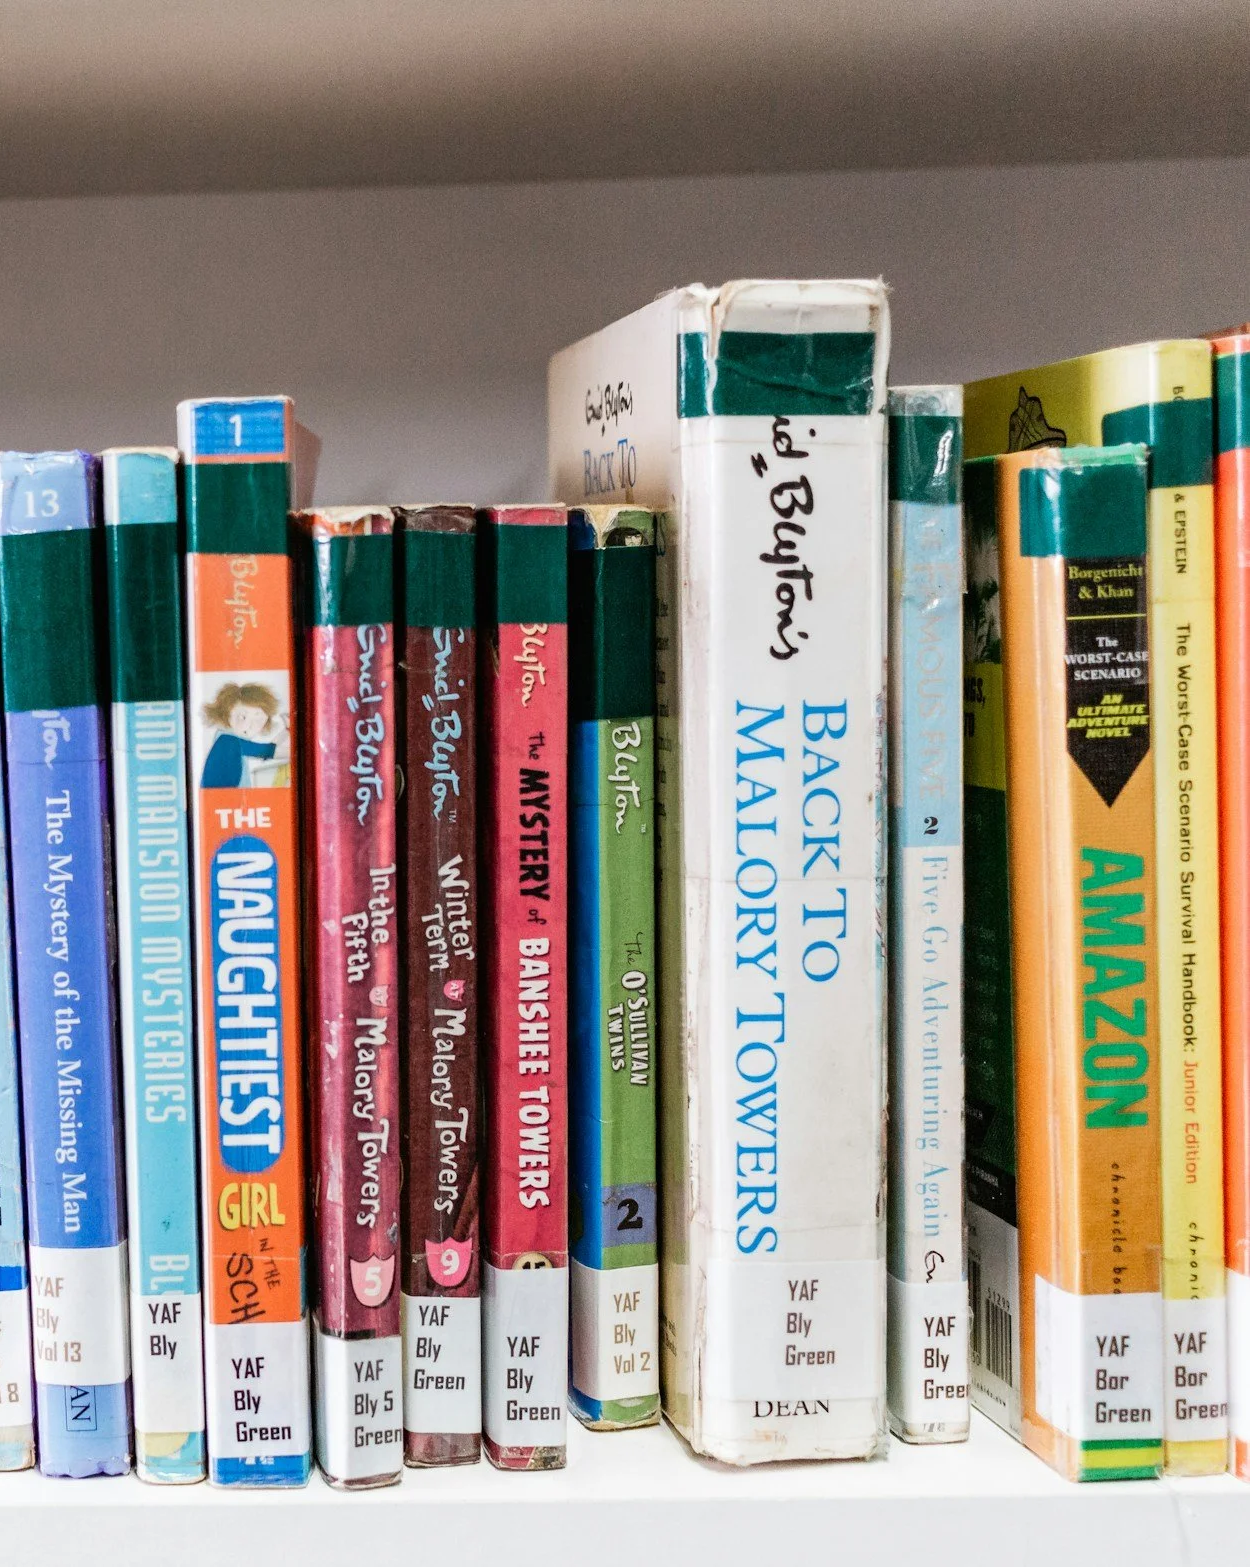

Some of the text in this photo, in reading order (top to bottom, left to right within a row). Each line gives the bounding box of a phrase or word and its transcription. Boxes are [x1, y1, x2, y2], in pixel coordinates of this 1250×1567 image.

[24, 490, 60, 518] 13
[1174, 511, 1190, 574] EPSTEIN
[759, 475, 815, 661] Blyton's
[1068, 564, 1144, 583] Borgenicht
[1097, 585, 1135, 599] Khan
[1064, 650, 1149, 665] WORST-CASE
[1074, 667, 1142, 681] SCENARIO
[1066, 715, 1150, 729] ADVENTURE
[1077, 704, 1146, 718] ULTIMATE
[350, 711, 384, 827] Blyton
[424, 710, 461, 820] Blyton
[608, 721, 641, 834] Blyton
[214, 806, 272, 831] THE
[922, 816, 939, 836] 2
[801, 699, 848, 985] BACK TO
[437, 854, 474, 961] Winter
[1177, 622, 1201, 1185] The Worst-Case Scenario Survival Junior Edition
[342, 911, 371, 983] Fifth
[422, 903, 449, 972] Term
[518, 731, 550, 1209] The MYSTERY BANSHEE TOWERS
[736, 700, 786, 1255] MALORY TOWERS
[1080, 846, 1150, 1129] AMAZON
[43, 790, 87, 1234] The Mystery of the Missing Man
[216, 850, 282, 1156] NAUGHTIEST
[607, 1002, 625, 1072] TWINS
[914, 856, 949, 1237] Five Go Adventuring Again
[352, 1017, 387, 1122] Malory
[430, 1008, 466, 1110] Malory
[434, 1106, 469, 1214] Towers
[356, 1118, 389, 1229] Towers
[217, 1182, 286, 1232] GIRL
[616, 1198, 644, 1231] 2
[440, 1248, 459, 1276] 9
[363, 1266, 381, 1296] 5
[787, 1279, 819, 1301] YAF
[148, 1302, 181, 1324] YAF
[418, 1305, 450, 1327] YAF
[786, 1313, 812, 1337] Bly
[924, 1316, 955, 1338] YAF
[150, 1335, 177, 1360] Bly
[416, 1338, 441, 1362] Bly
[507, 1337, 540, 1358] YAF
[1096, 1336, 1130, 1358] YAF
[1174, 1331, 1207, 1355] YAF
[613, 1354, 635, 1375] Vol
[785, 1345, 835, 1366] Green
[924, 1348, 949, 1372] Bly
[231, 1357, 265, 1379] YAF
[354, 1360, 384, 1383] YAF
[414, 1369, 465, 1390] Green
[1095, 1369, 1129, 1391] Bor
[1174, 1365, 1207, 1388] Bor
[507, 1369, 533, 1393] Bly
[234, 1390, 261, 1414] Bly
[507, 1400, 561, 1421] Green
[753, 1400, 830, 1418] DEAN
[1095, 1402, 1151, 1423] Green
[236, 1422, 291, 1442] Green
[354, 1427, 402, 1447] Green
